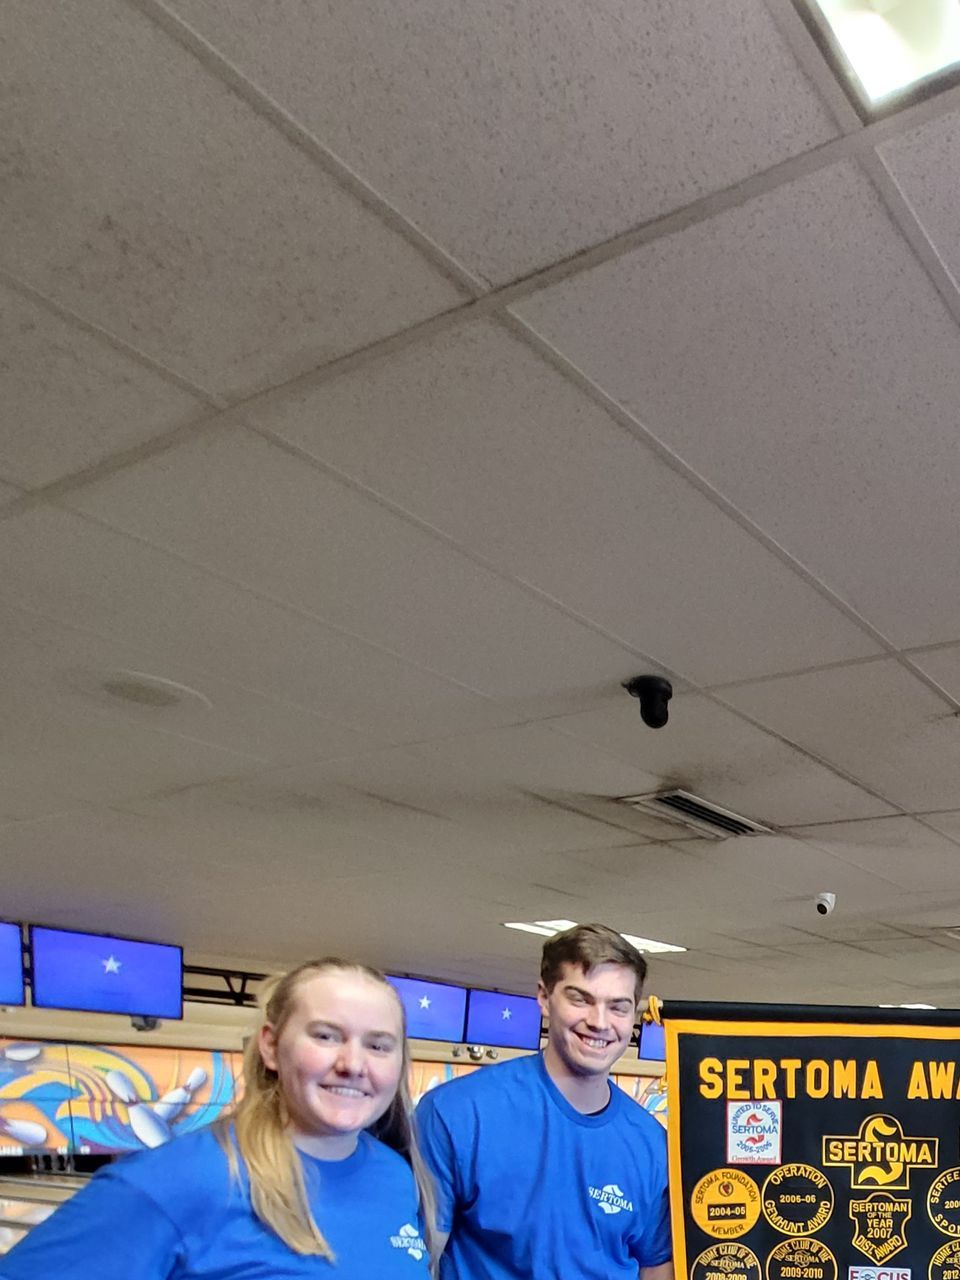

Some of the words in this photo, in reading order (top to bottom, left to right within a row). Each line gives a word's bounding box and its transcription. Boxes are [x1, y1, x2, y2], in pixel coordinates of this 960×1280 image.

[699, 1057, 884, 1100] SERTOMA
[732, 1125, 778, 1135] SERTOMA
[829, 1141, 933, 1164] SERTOMA
[695, 1175, 720, 1204] SERTOMA
[721, 1172, 758, 1203] FOUNDATION
[770, 1166, 827, 1189] OPERATION
[589, 1186, 633, 1212] SERTOMA
[779, 1194, 817, 1203] 2005-06
[852, 1202, 907, 1213] SERTOMAN
[710, 1206, 746, 1217] 2004-05
[765, 1199, 804, 1233] GEMHUNT
[807, 1201, 830, 1231] AWARD
[711, 1224, 745, 1235] MEMBER
[866, 1228, 893, 1239] 2007
[867, 1219, 894, 1228] YEAR
[699, 1248, 719, 1266] HOME
[719, 1246, 739, 1255] CLUB
[744, 1253, 757, 1270] THE
[773, 1243, 793, 1262] HOME
[791, 1240, 810, 1250] CLUB
[818, 1249, 832, 1263] THE
[874, 1235, 903, 1260] AWARD
[933, 1245, 953, 1267] HOME
[780, 1266, 824, 1279] 2009-2010
